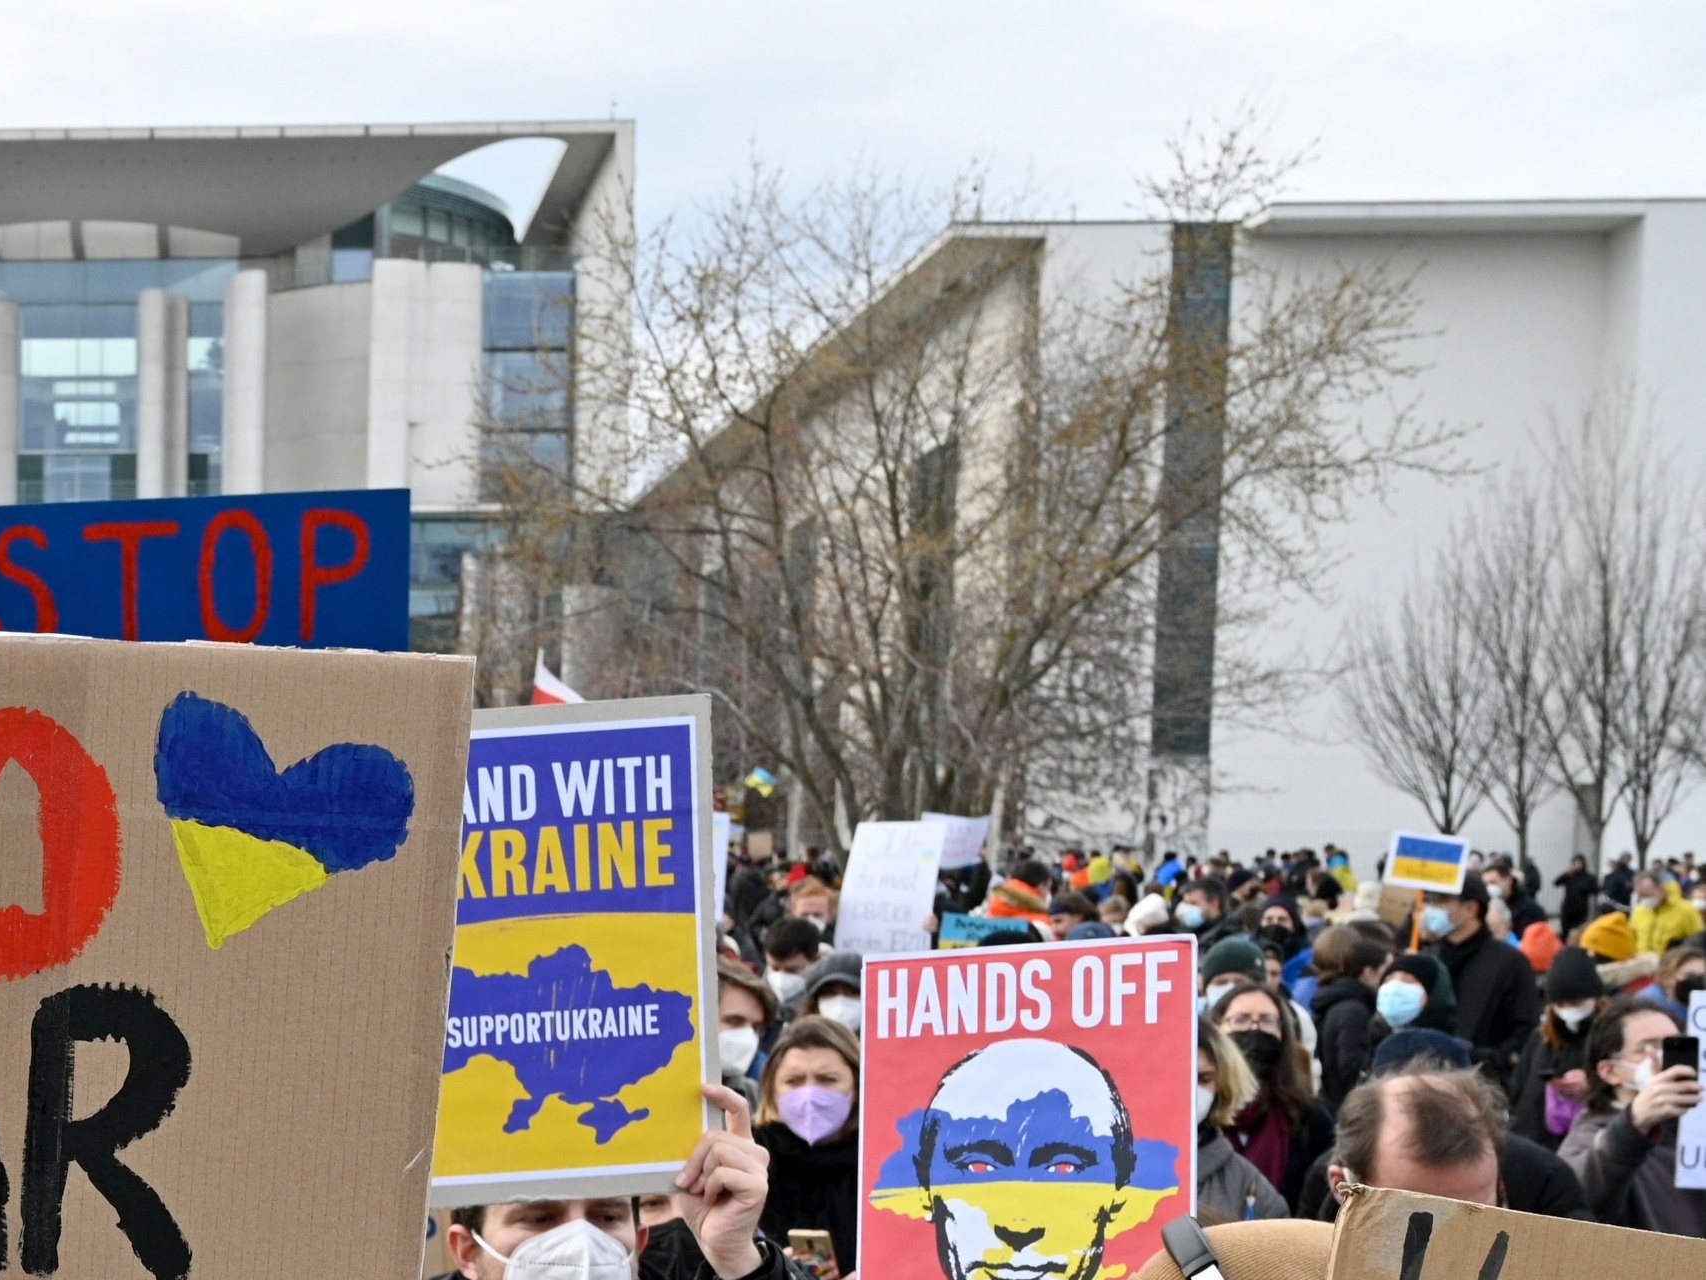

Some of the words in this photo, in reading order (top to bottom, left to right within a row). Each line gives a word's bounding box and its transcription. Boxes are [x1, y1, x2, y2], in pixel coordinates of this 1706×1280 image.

[552, 754, 672, 819] WITH
[457, 818, 675, 899] KRAINE
[448, 1004, 660, 1049] SUPPORTUKRAINE
[877, 958, 1053, 1039] HANDS
[1071, 950, 1179, 1029] OFF
